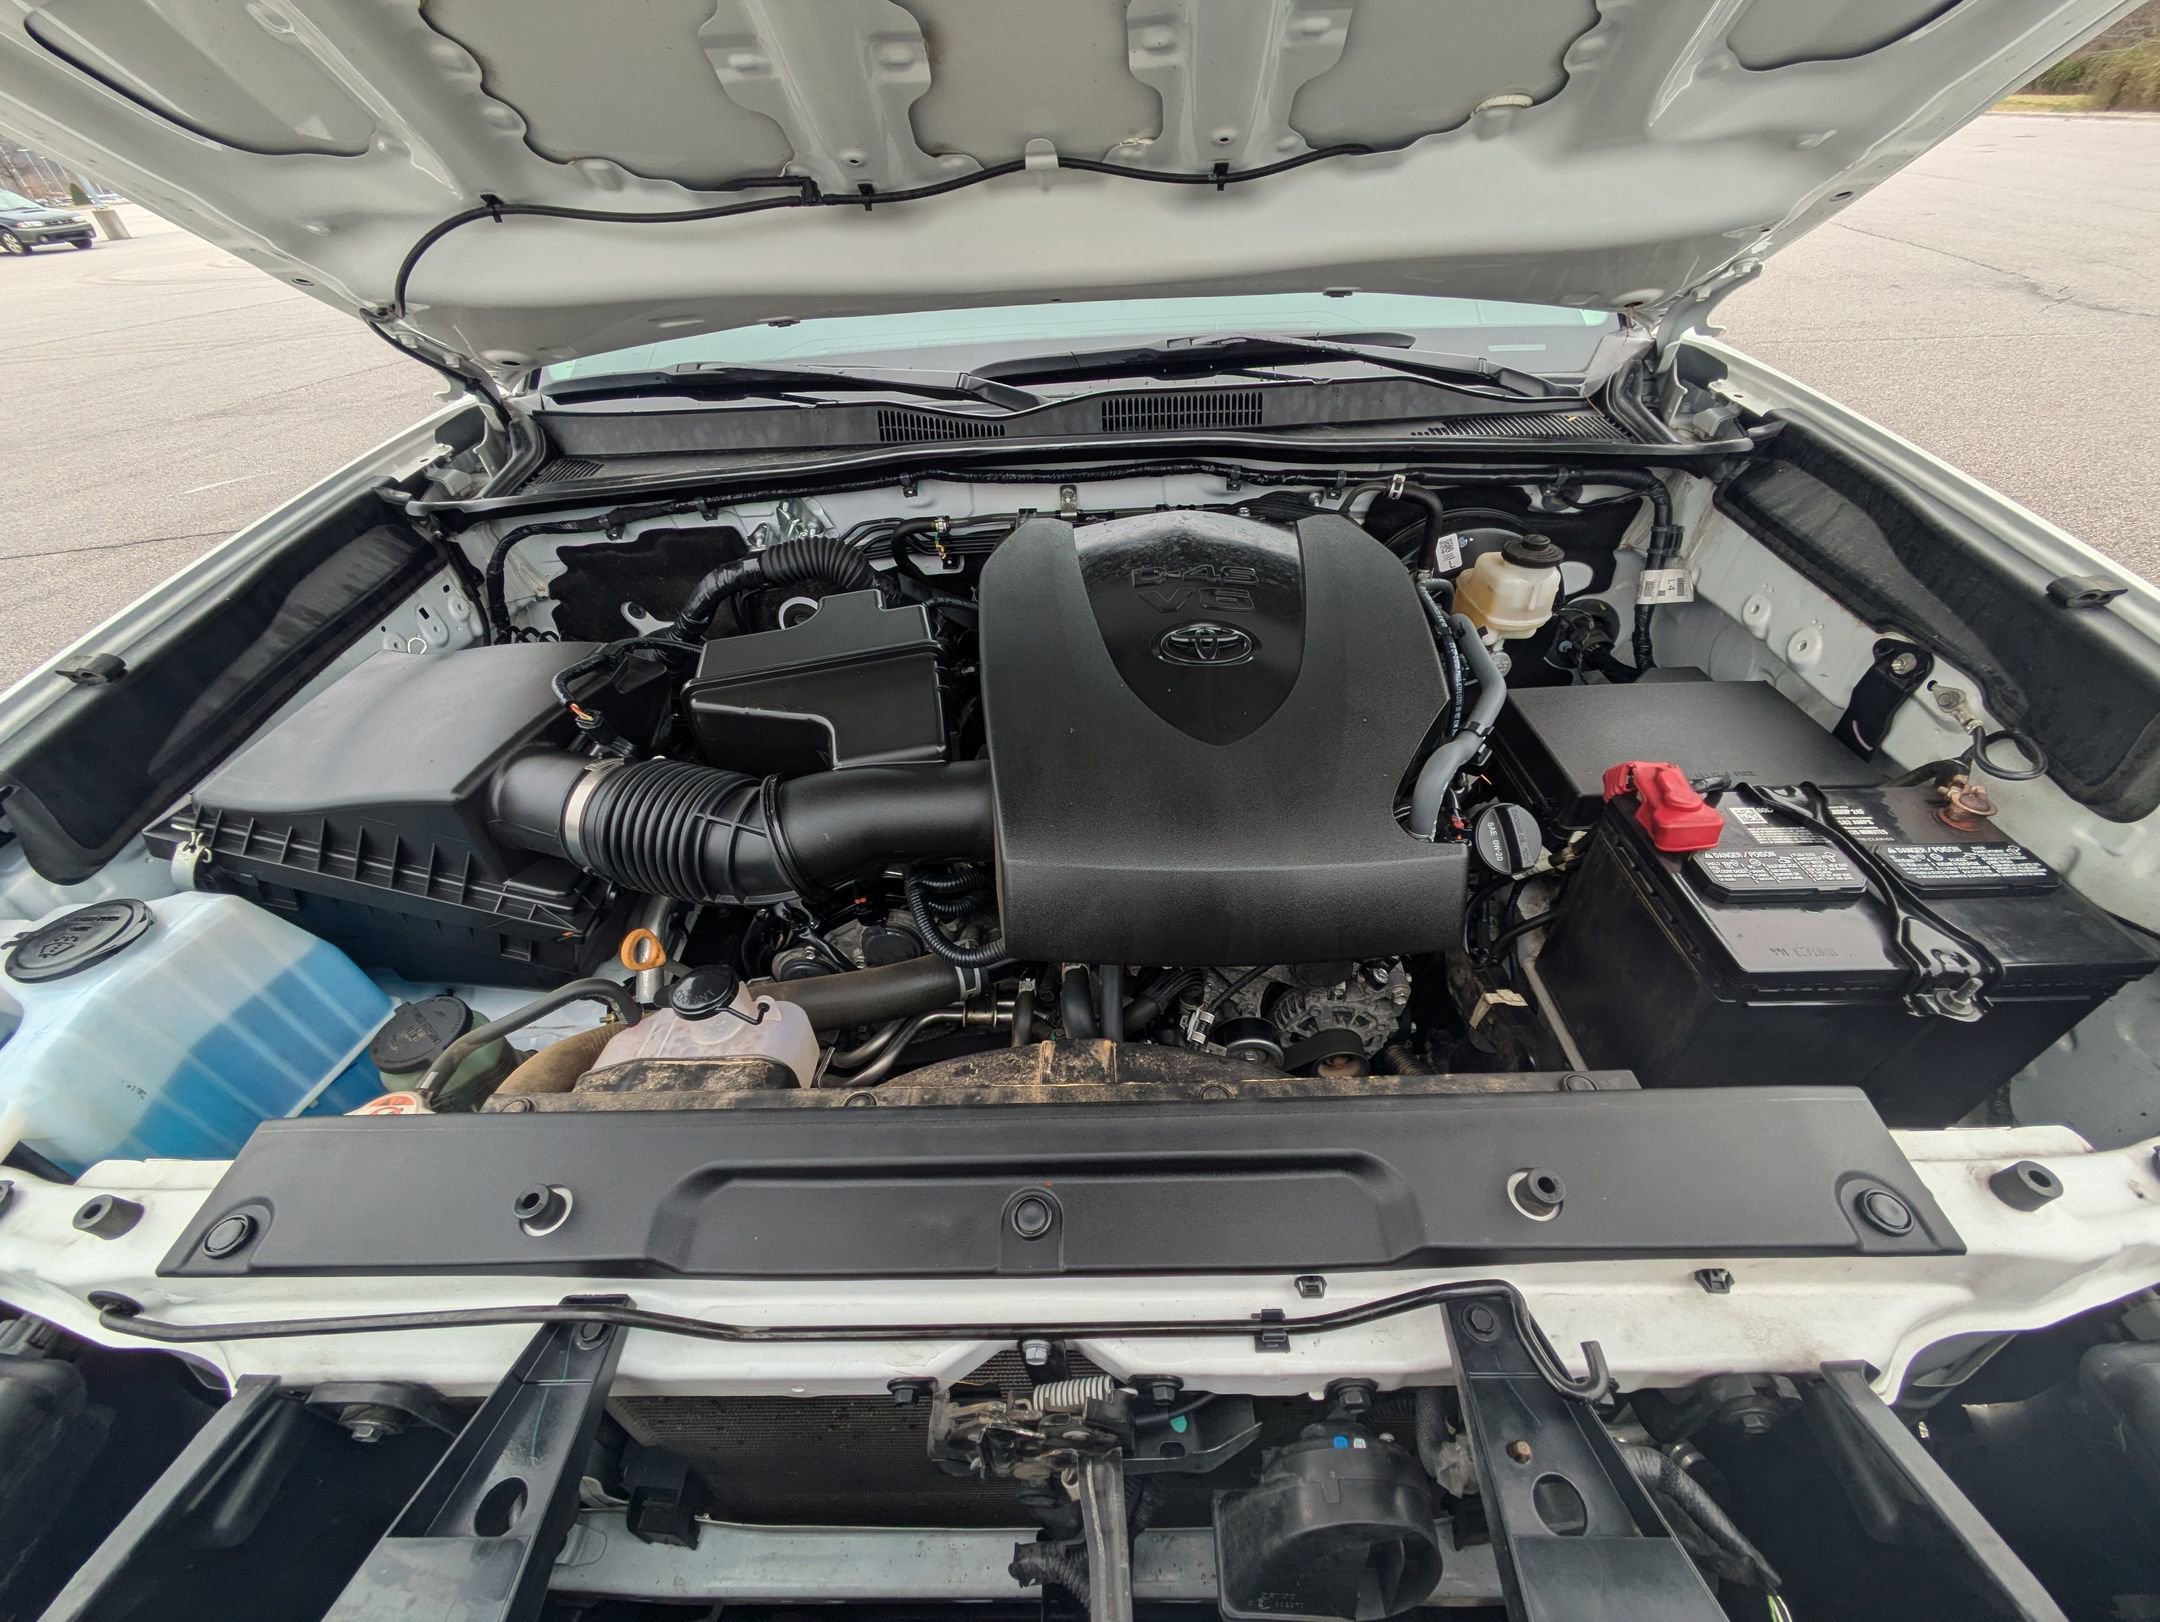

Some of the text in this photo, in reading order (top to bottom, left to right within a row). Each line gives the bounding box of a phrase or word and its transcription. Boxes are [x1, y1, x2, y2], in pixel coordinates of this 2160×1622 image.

[1138, 586, 1256, 614] V6
[1487, 822, 1503, 861] SAE 0W-20
[1712, 851, 1744, 859] DANGER
